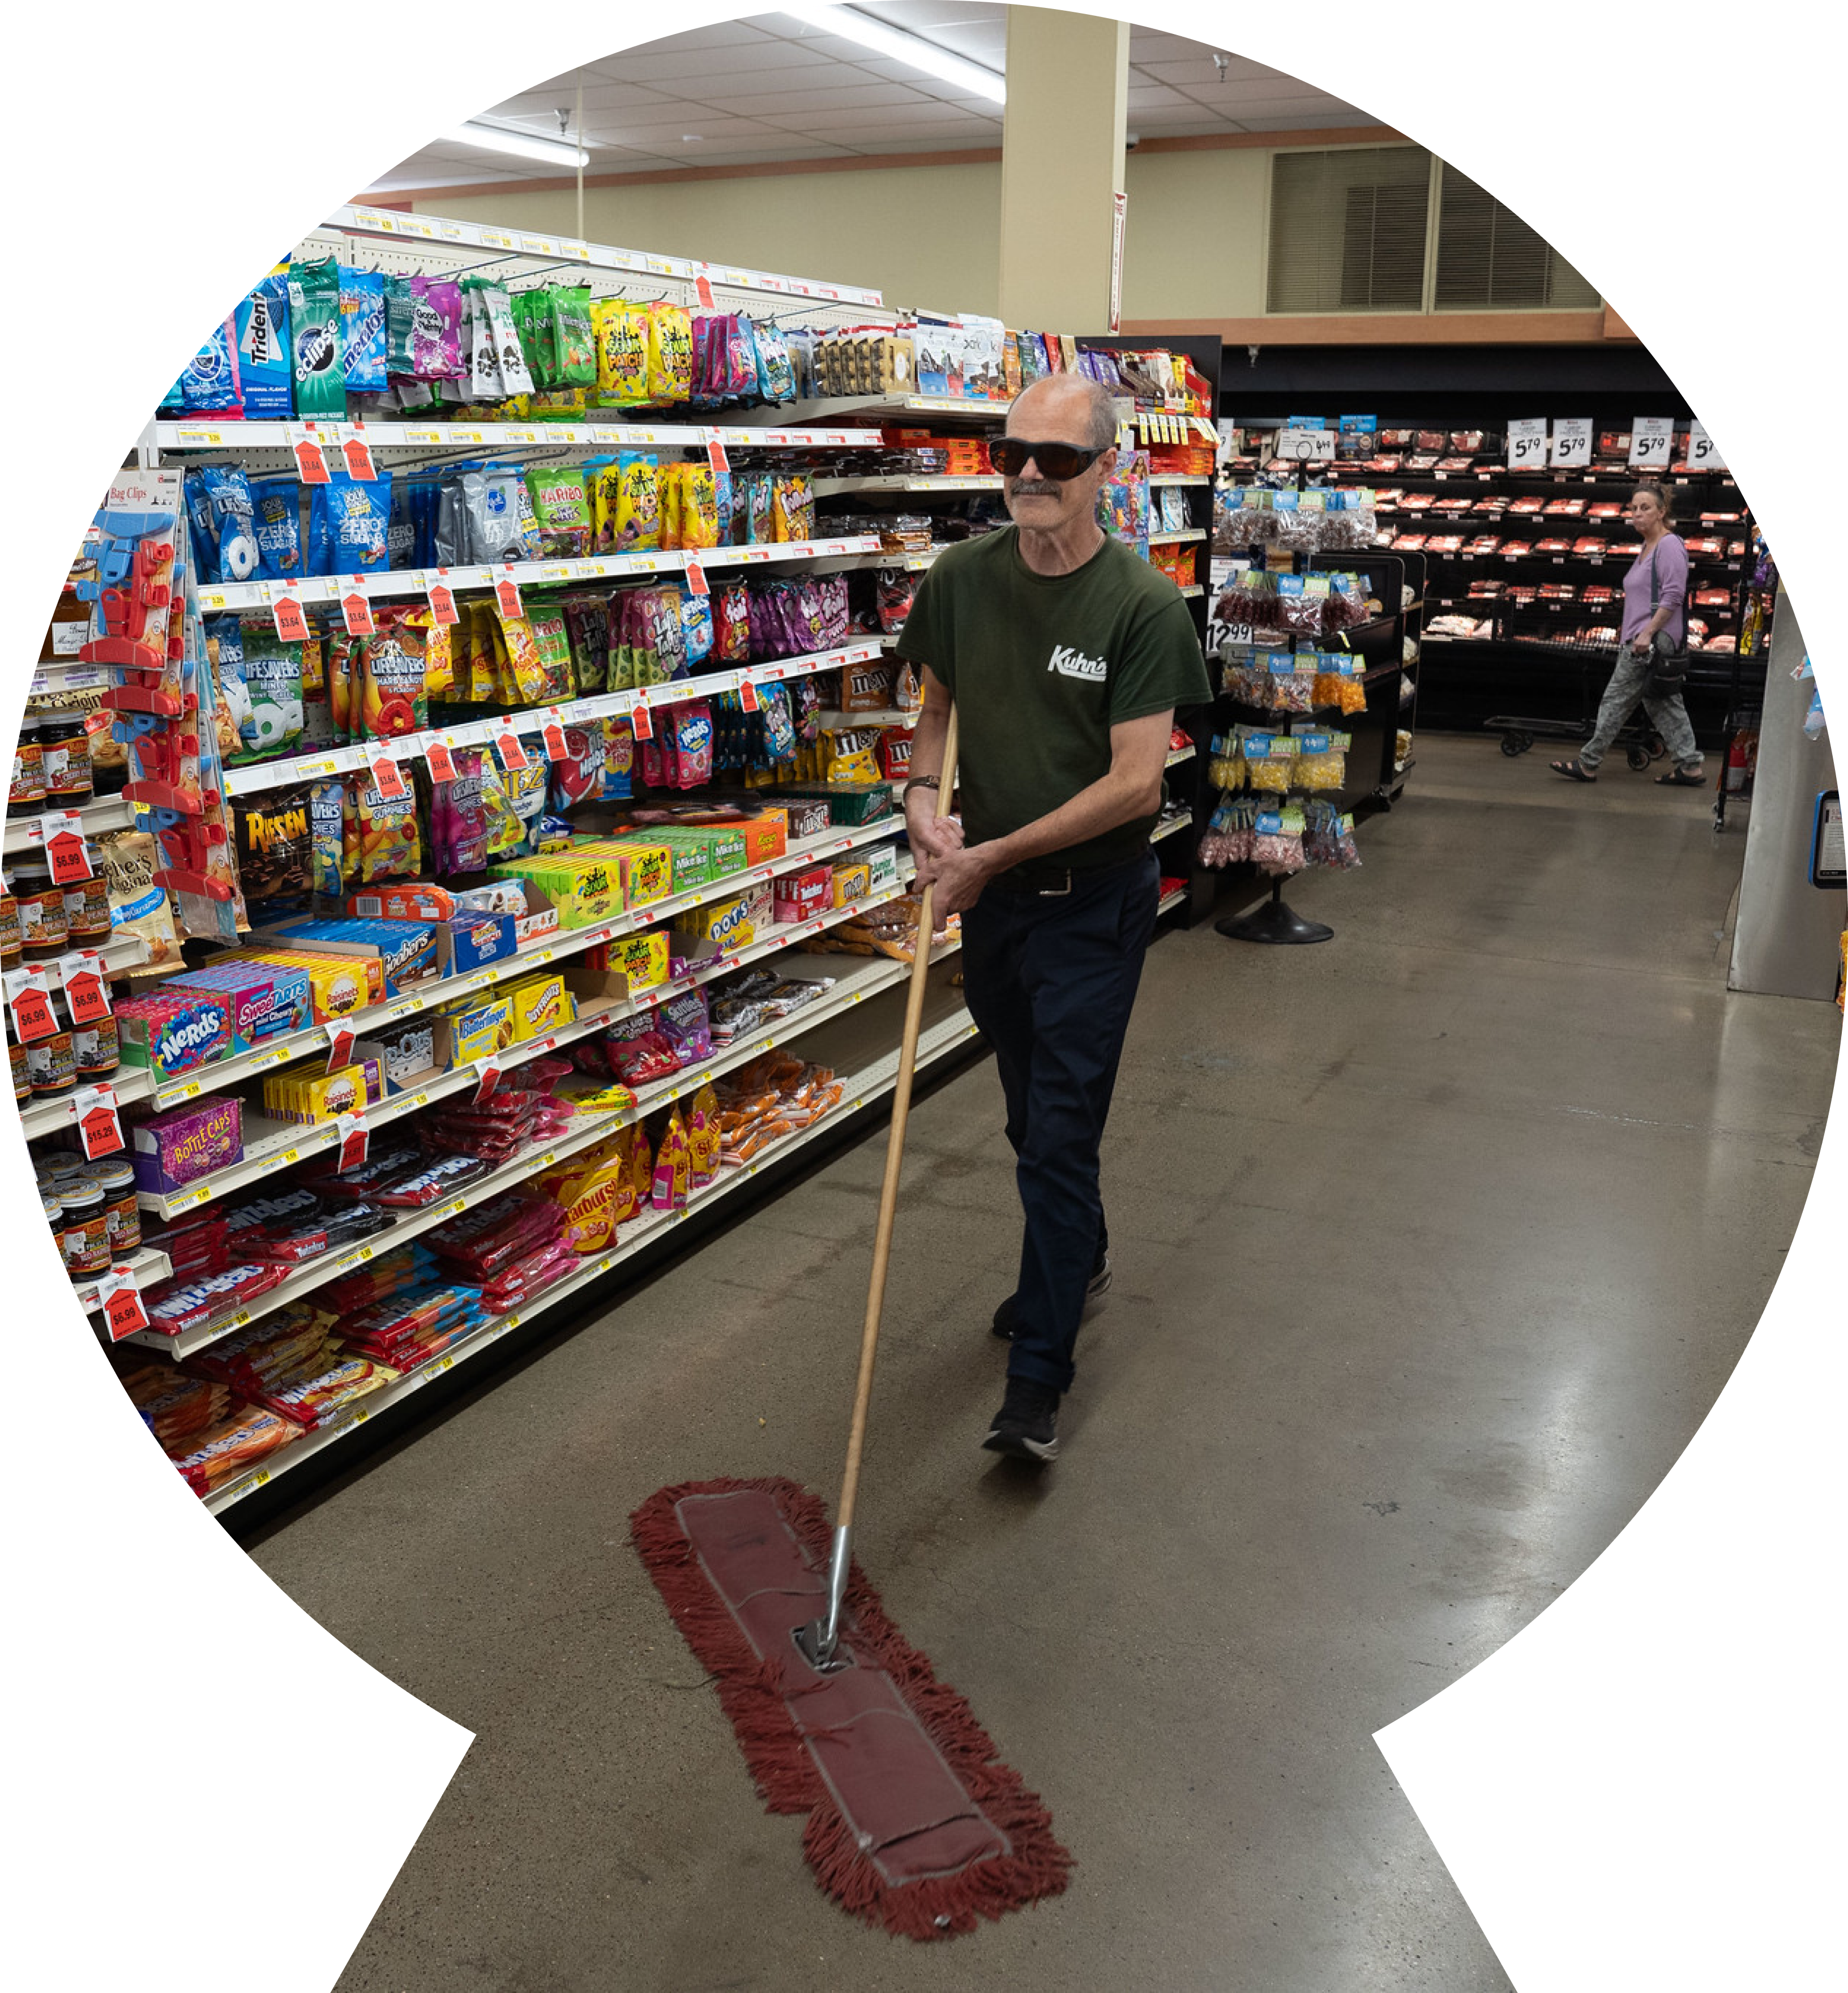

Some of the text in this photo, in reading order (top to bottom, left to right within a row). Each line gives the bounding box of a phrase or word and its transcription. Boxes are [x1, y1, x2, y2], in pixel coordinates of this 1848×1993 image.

[417, 307, 438, 320] Good
[251, 292, 268, 365] Trident
[296, 318, 339, 382] eclipse
[608, 353, 643, 369] PATCH
[1515, 437, 1541, 458] 579
[1560, 437, 1585, 457] 579
[1638, 437, 1665, 457] 579
[1695, 439, 1715, 459] 57
[110, 486, 147, 502] Bag Clips
[540, 486, 583, 506] HARIBO
[339, 518, 382, 533] ZERO
[280, 617, 300, 628] $3.64
[349, 612, 366, 622] $3.64
[370, 657, 425, 676] LIFESAVERS
[1048, 645, 1107, 674] Kuhn's
[588, 732, 605, 753] AIR
[371, 803, 413, 820] GUMMIES
[246, 808, 307, 854] RIESEN
[55, 853, 80, 868] $6.99
[716, 845, 733, 857] Mike
[677, 857, 694, 870] Mike
[872, 857, 893, 874] Junior
[711, 900, 748, 941] DOTS
[384, 930, 430, 976] Goobers
[75, 992, 98, 1007] $6.99
[326, 986, 360, 1006] Raisinets
[20, 1009, 45, 1026] $6.99
[269, 1007, 293, 1021] Chewy
[460, 1005, 507, 1040] Butterfinger
[323, 1087, 358, 1107] Raisinets
[87, 1126, 113, 1143] $15.29
[174, 1111, 232, 1165] BOTTLE CAPS
[113, 1307, 136, 1325] $6.99
